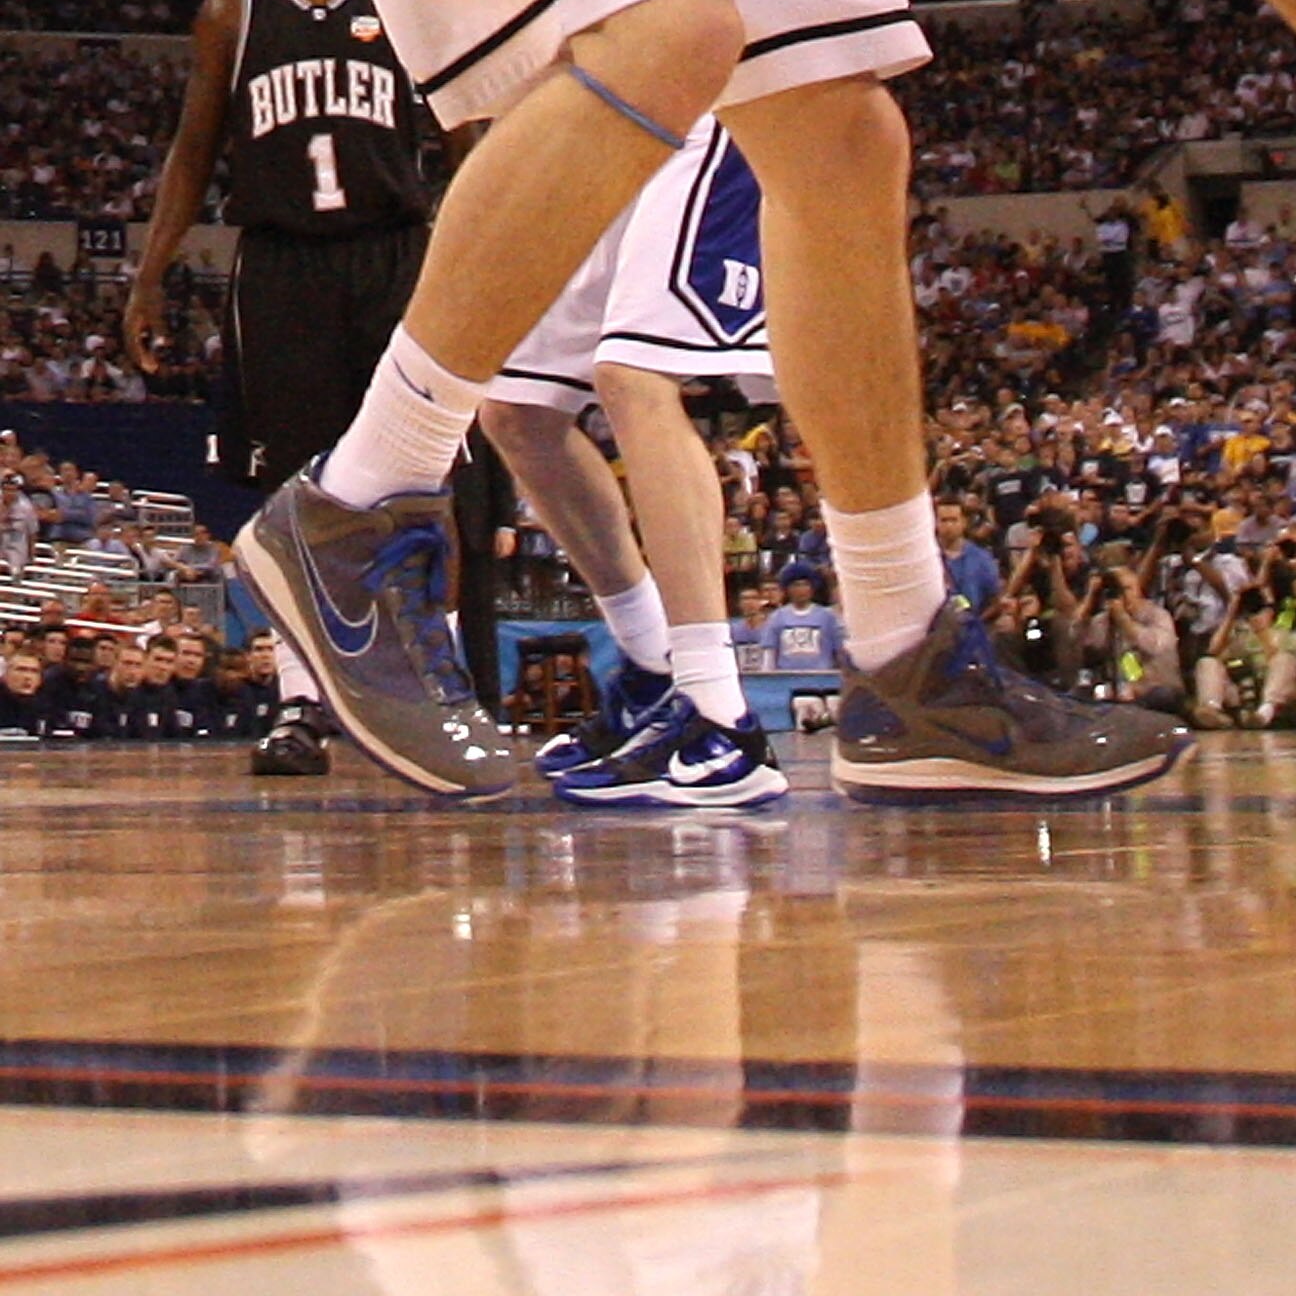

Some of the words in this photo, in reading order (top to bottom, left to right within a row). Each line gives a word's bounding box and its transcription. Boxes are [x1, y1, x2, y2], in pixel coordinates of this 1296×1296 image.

[249, 59, 397, 140] BUTLER
[307, 133, 347, 211] 1
[81, 229, 122, 250] 121
